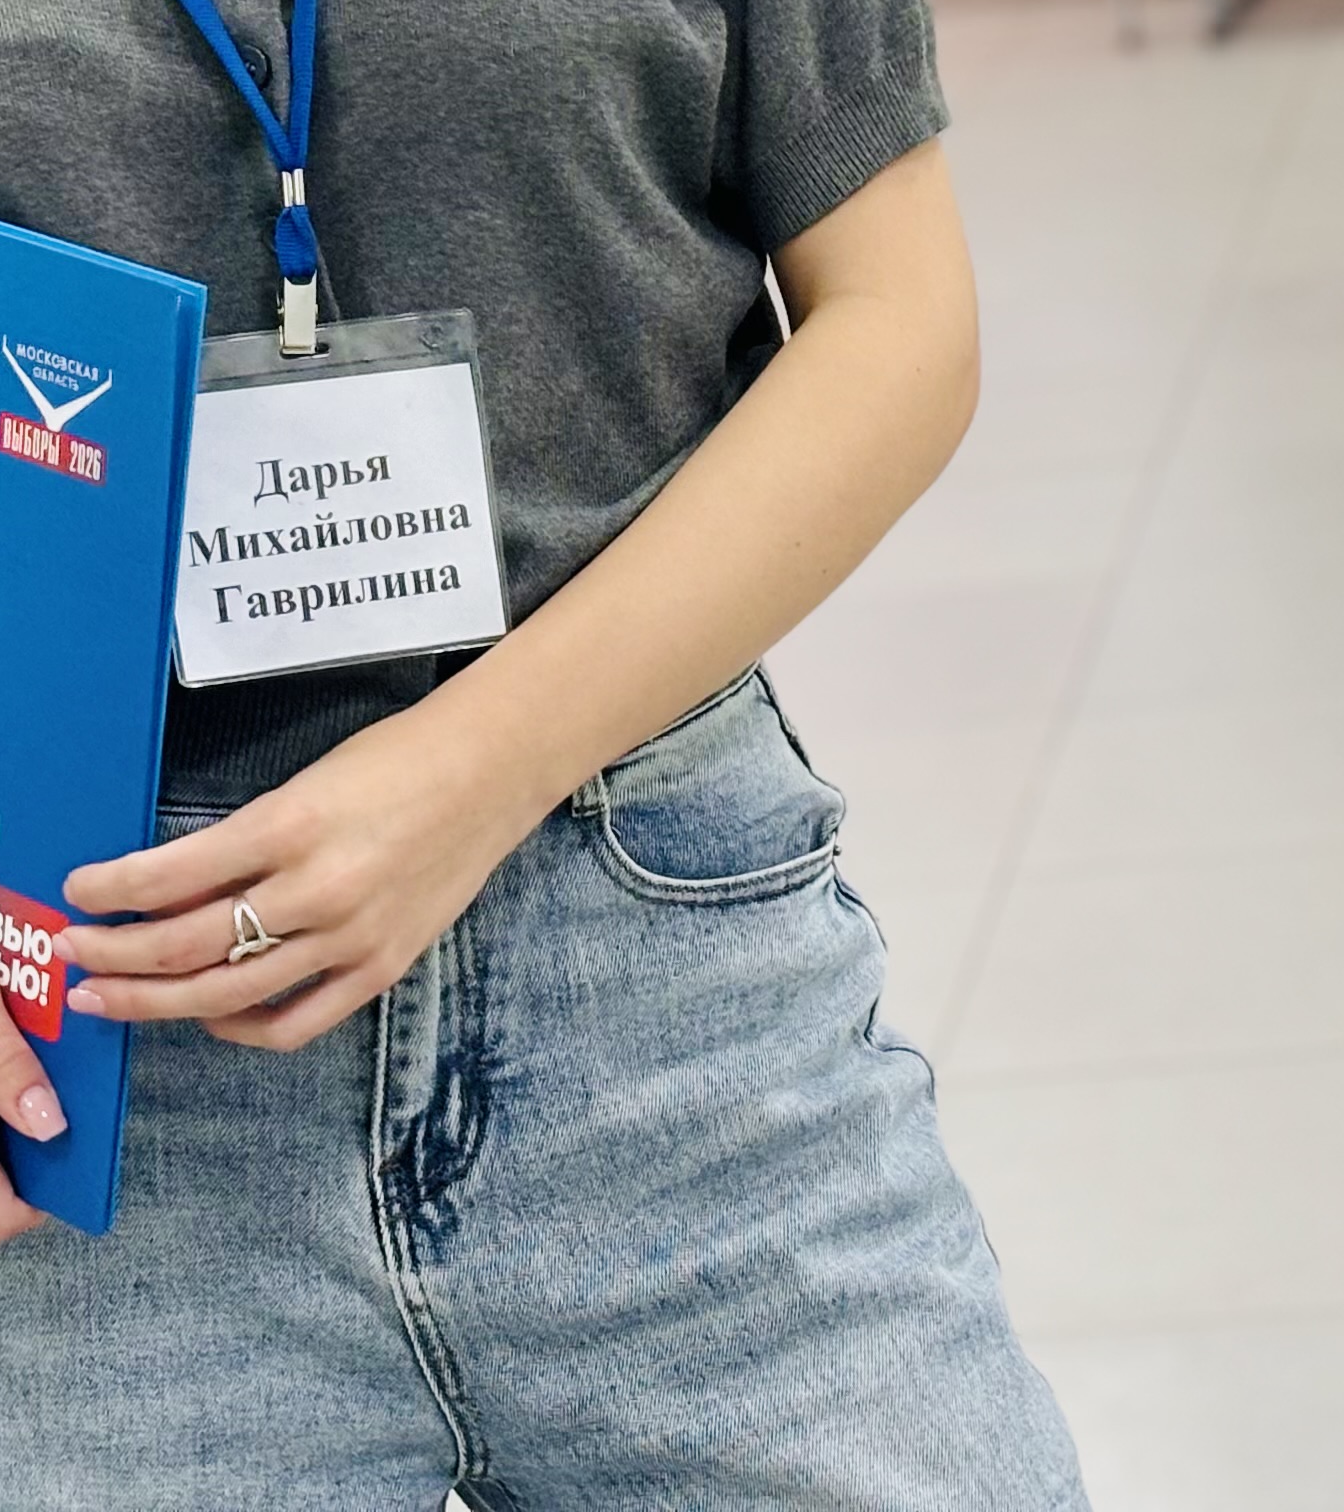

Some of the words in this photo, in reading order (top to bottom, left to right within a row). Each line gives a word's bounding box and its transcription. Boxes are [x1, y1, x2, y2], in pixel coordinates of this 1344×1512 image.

[16, 343, 99, 382] МОСКОВСКАЯ
[32, 366, 80, 392] ОБЛАСТЬ
[3, 417, 60, 466] ВЫБОРЫ
[69, 440, 103, 481] 2026
[253, 453, 392, 507] Дарья
[185, 502, 473, 568] Михайловна
[212, 562, 462, 624] Гаврилина
